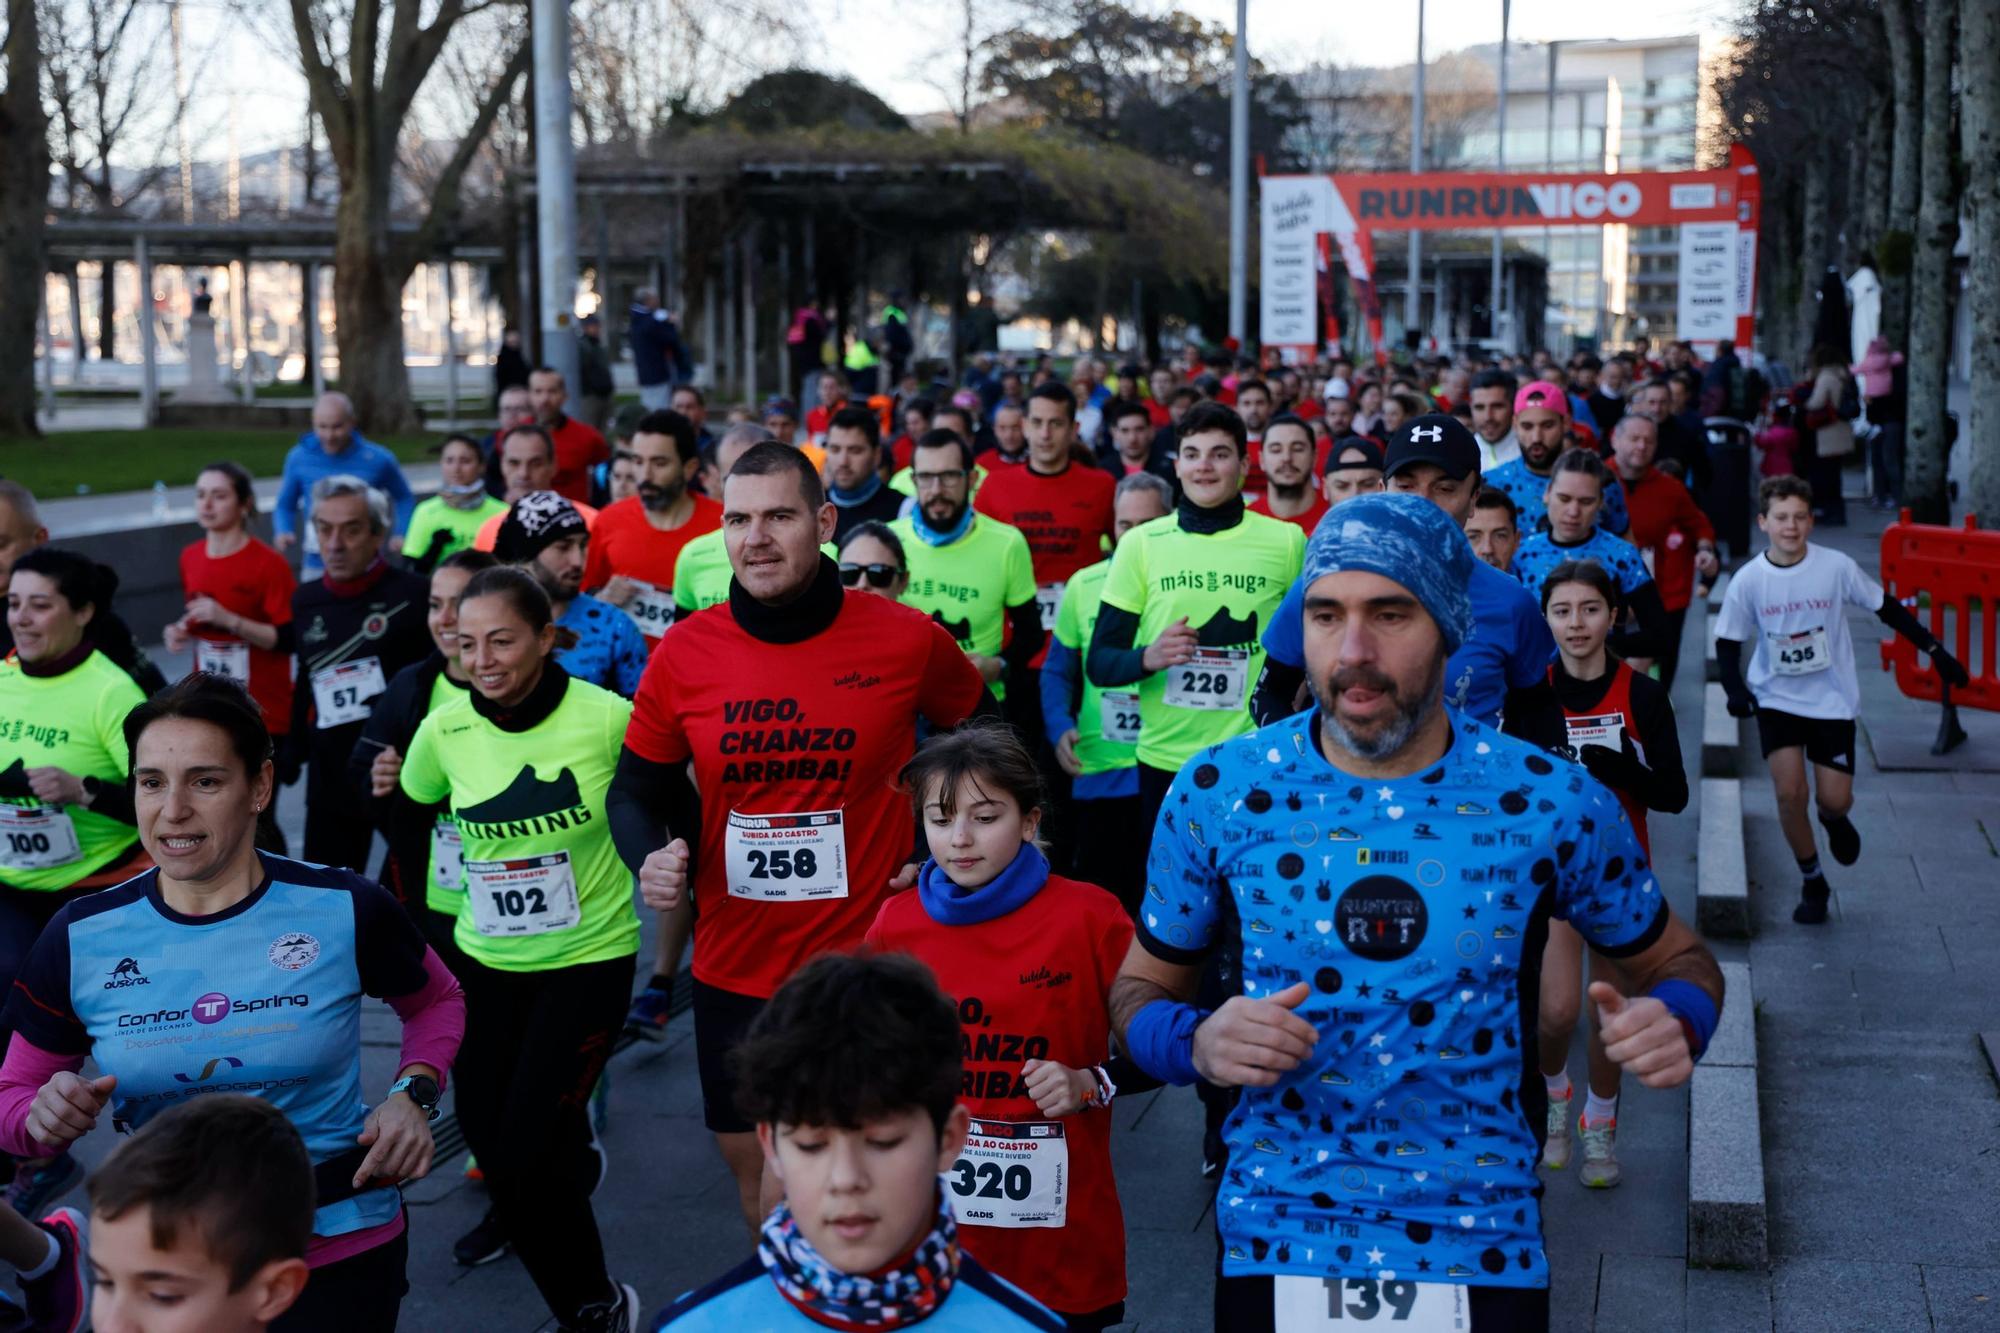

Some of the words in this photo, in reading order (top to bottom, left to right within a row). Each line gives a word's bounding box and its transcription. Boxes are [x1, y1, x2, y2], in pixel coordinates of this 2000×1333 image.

[1161, 571, 1204, 592] máis
[1222, 574, 1267, 594] auga
[1781, 646, 1815, 664] 435
[1182, 671, 1228, 695] 228
[333, 687, 358, 709] 57
[724, 698, 806, 724] VIGO,
[1116, 713, 1142, 730] 22
[720, 728, 857, 755] CHANZO
[722, 758, 853, 784] ARRIBA!
[7, 832, 49, 853] 100
[742, 831, 769, 839] SUBIDA
[785, 829, 818, 838] CASTRO
[1472, 833, 1495, 847] RUN
[1512, 834, 1532, 848] TRI
[747, 848, 817, 879] 258
[492, 887, 548, 917] 102
[104, 976, 151, 990] austral
[118, 1009, 190, 1028] Confor
[232, 993, 309, 1014] Spring
[149, 1022, 193, 1033] DESCANSO
[960, 1033, 1049, 1062] ANZO
[974, 1150, 1004, 1159] ALVAREZ
[983, 1140, 996, 1149] AO
[998, 1142, 1038, 1151] CASTRO
[951, 1159, 1032, 1201] 320
[967, 1210, 994, 1219] GADIS
[1322, 1277, 1418, 1320] 139
